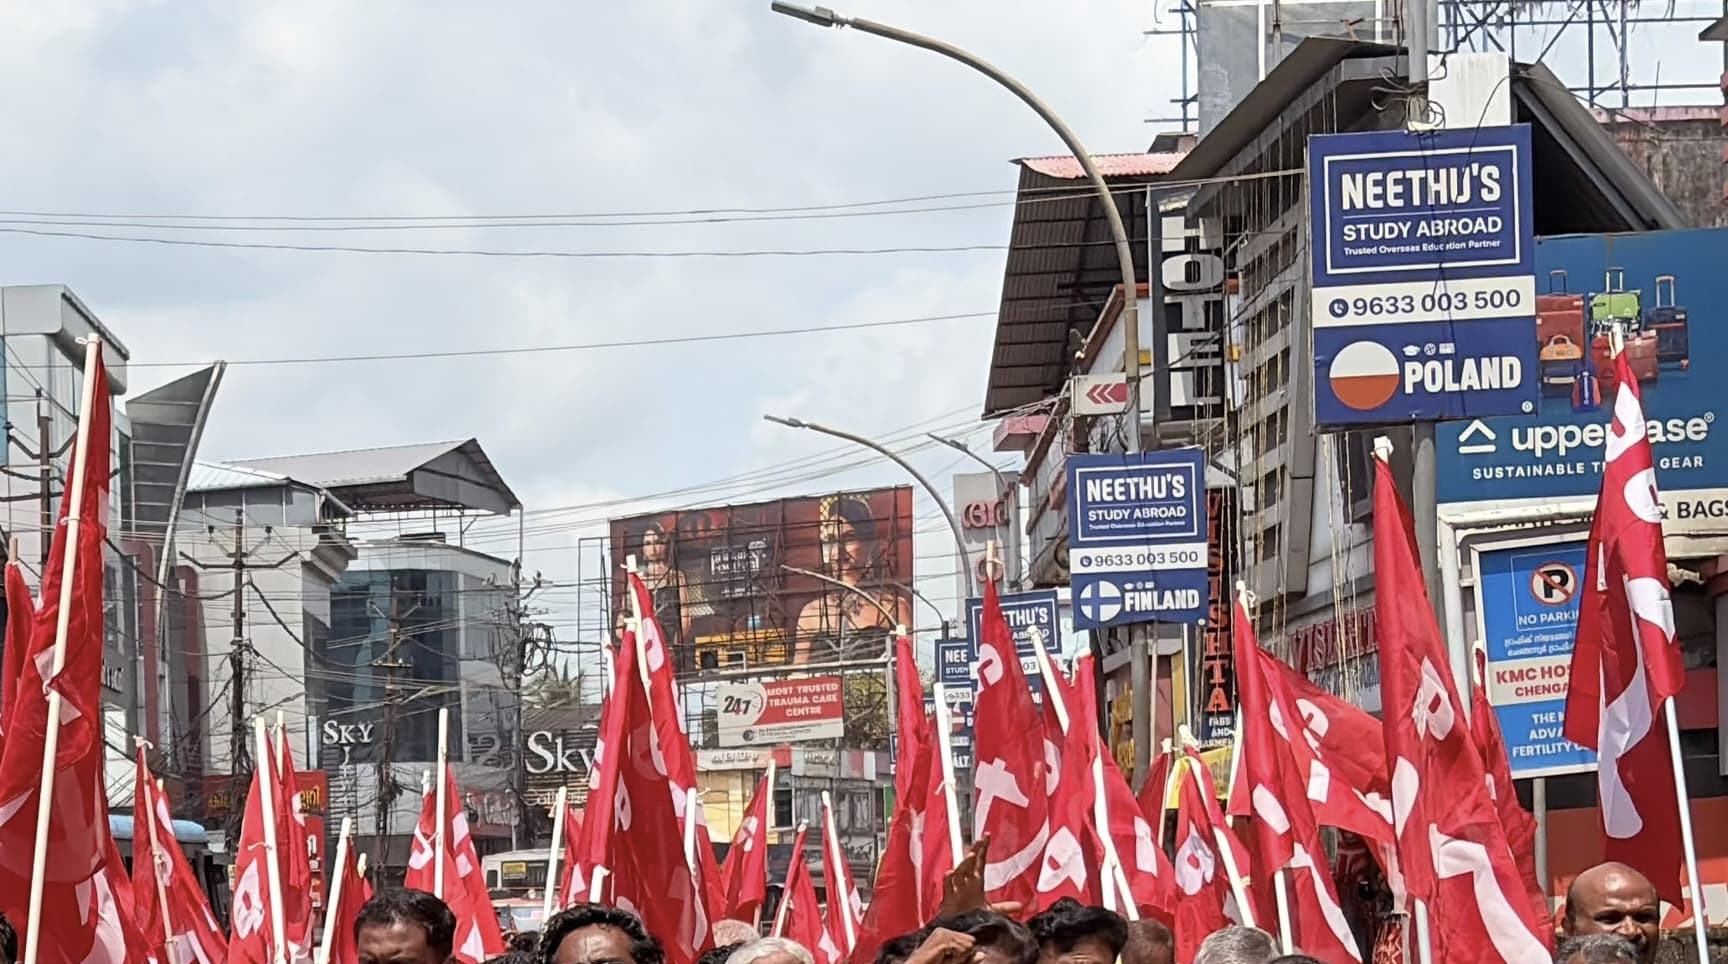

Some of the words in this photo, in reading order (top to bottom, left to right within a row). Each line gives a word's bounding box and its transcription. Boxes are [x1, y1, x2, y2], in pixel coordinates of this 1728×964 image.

[1341, 163, 1501, 210] NEETHU'S
[1343, 220, 1411, 242] STUDY
[1416, 215, 1503, 238] ABROAD
[1344, 246, 1378, 256] Trusted
[1379, 243, 1420, 255] Overseas
[1422, 240, 1467, 252] Education
[1468, 238, 1501, 249] Partner
[1161, 216, 1224, 407] HOTEL
[1352, 296, 1415, 316] 9633
[1421, 293, 1468, 312] 003
[1474, 289, 1521, 309] 500
[1404, 356, 1522, 394] POLAND
[1512, 417, 1709, 457] upperase
[1473, 463, 1585, 479] SUSTAINABLE
[1659, 456, 1703, 470] GEAR
[1086, 474, 1185, 502] NEETHU'S
[1088, 509, 1130, 521] STUDY
[1133, 505, 1187, 520] ABROAD
[1094, 555, 1134, 568] 9633
[1136, 552, 1166, 566] 003
[1169, 550, 1199, 564] 500
[1124, 589, 1200, 612] FINLAND
[1518, 614, 1537, 626] NO
[1540, 610, 1580, 623] PARKI
[1496, 668, 1537, 684] KMC
[767, 686, 793, 696] MOST
[796, 683, 838, 694] TRUSTED
[1514, 683, 1569, 698] CHENGA
[769, 696, 809, 707] TRAUMA
[812, 694, 838, 703] CARE
[785, 706, 822, 717] CENTRE
[1532, 712, 1557, 725] THE
[323, 720, 373, 744] SKY
[1512, 742, 1571, 758] FERTILITY
